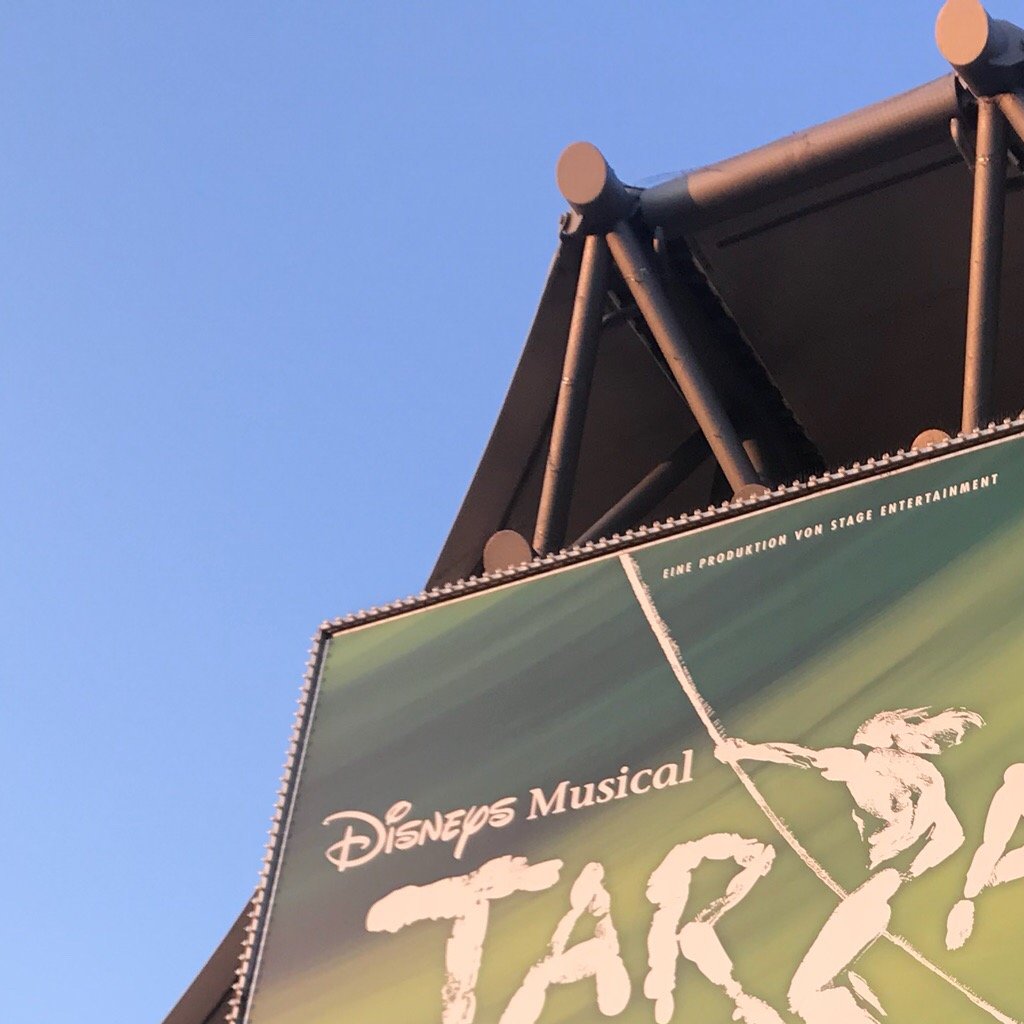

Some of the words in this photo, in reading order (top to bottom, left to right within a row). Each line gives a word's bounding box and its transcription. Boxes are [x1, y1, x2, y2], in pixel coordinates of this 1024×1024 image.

[662, 561, 693, 579] EINE
[698, 534, 787, 569] PRODUKTION
[794, 523, 823, 541] VON
[830, 509, 874, 531] STAGE
[880, 473, 999, 517] ENTERTAINMENT
[526, 749, 694, 820] Musical
